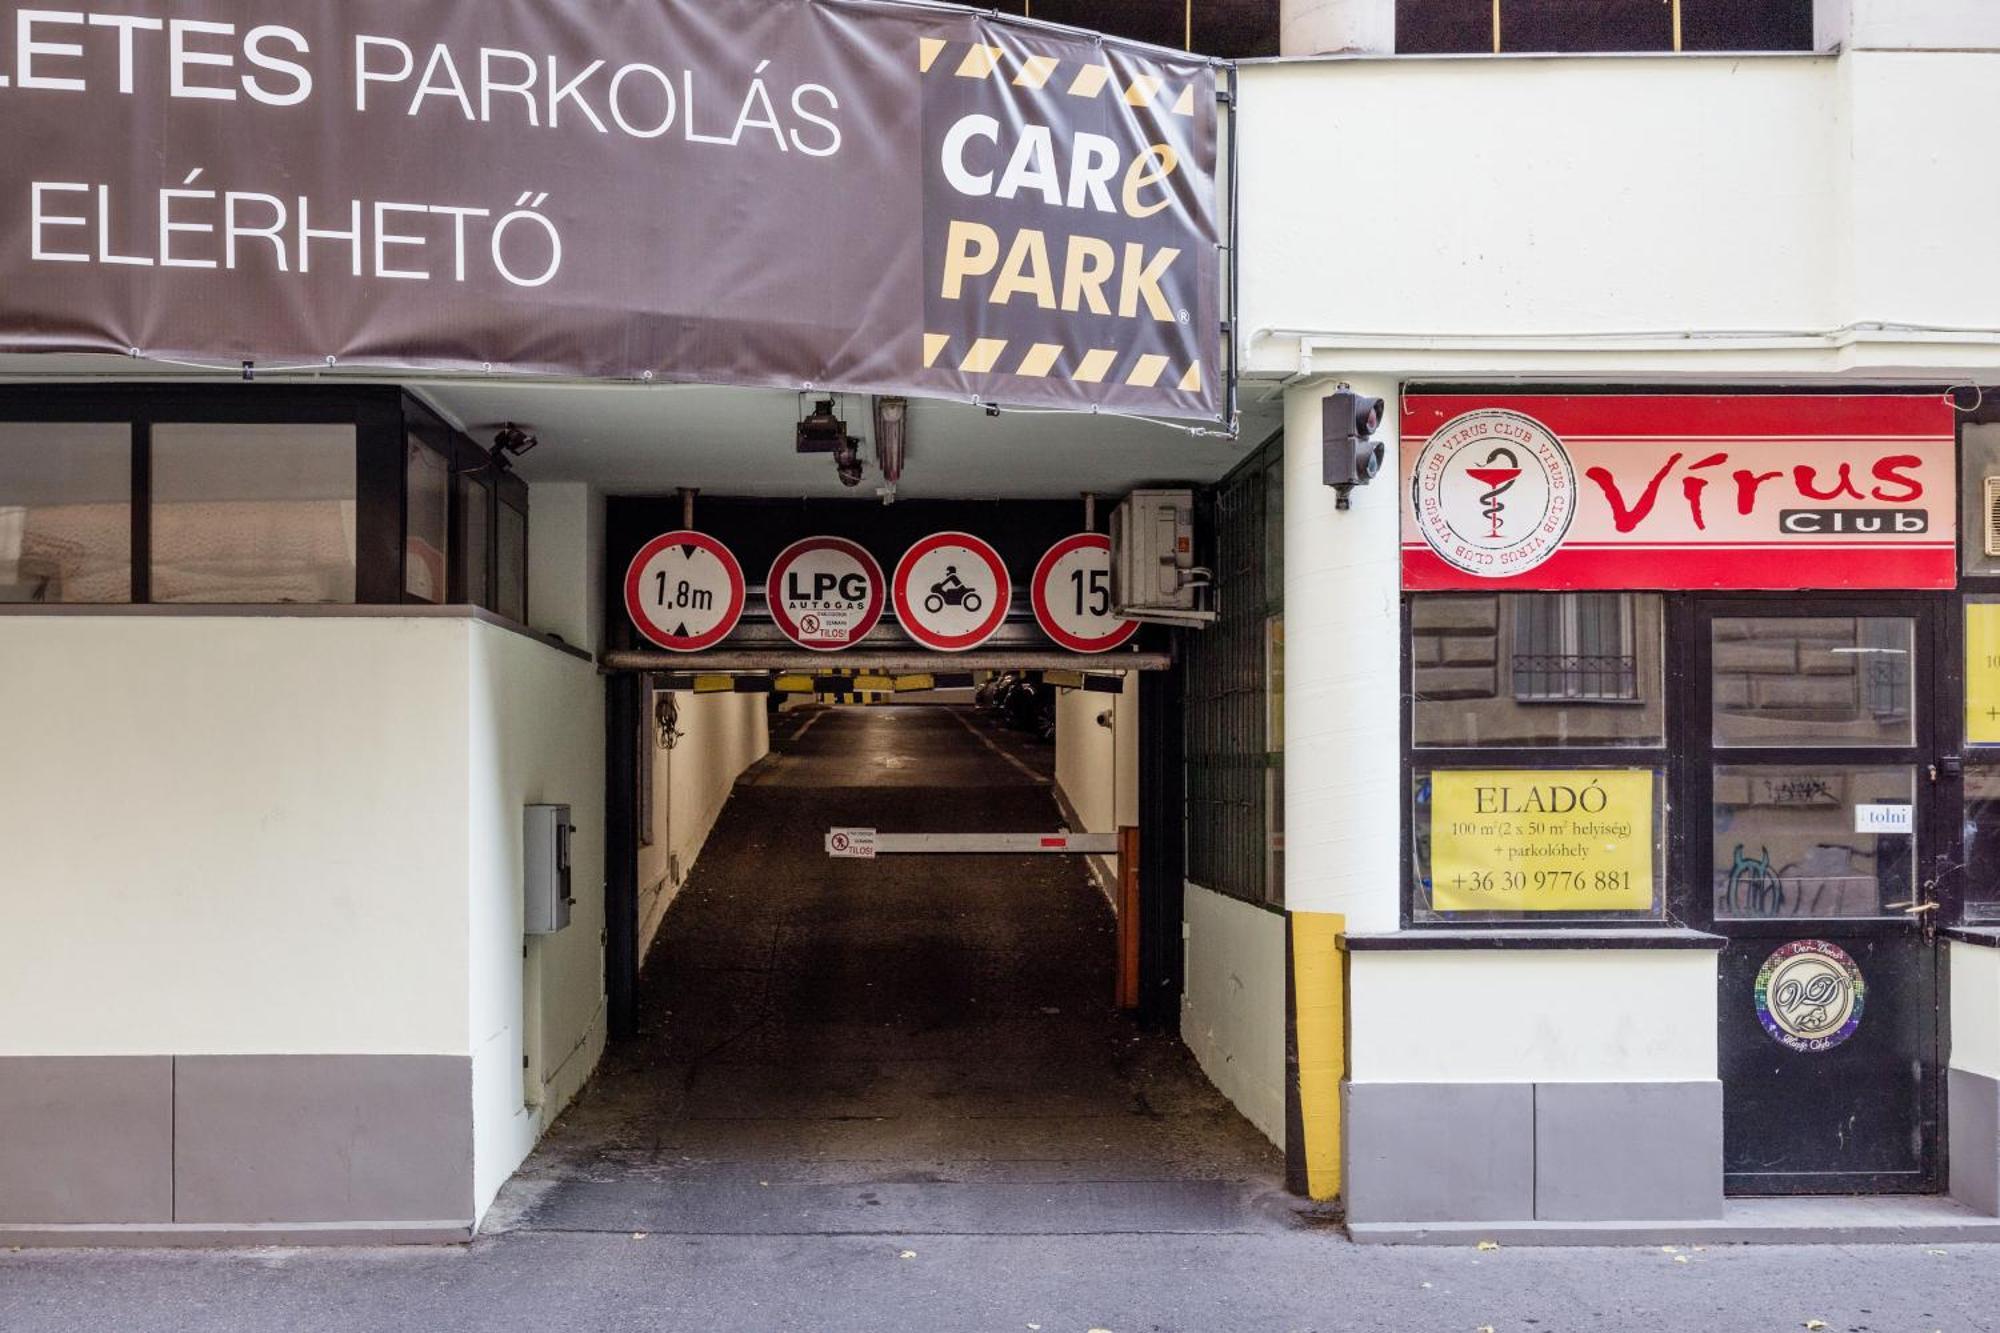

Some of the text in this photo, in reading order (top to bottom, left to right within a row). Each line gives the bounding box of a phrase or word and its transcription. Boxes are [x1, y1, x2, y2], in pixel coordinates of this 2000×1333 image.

[0, 8, 842, 157] ETES PARKOLÁS
[31, 167, 562, 287] ELÉRHETŐ
[1425, 423, 1565, 565] VIRUS CLUB VIRUS CLUB VIRUS CLUB VIRUS CLUB
[1585, 452, 1924, 533] Vírus
[1785, 512, 1925, 532] Club
[789, 572, 867, 601] LPG
[1071, 569, 1109, 617] 15
[789, 602, 865, 610] AUTOGAS
[1474, 778, 1608, 814] ELADÓ
[1452, 822, 1476, 836] 100
[1528, 822, 1545, 836] 50
[1573, 821, 1632, 839] helyiség)
[1870, 808, 1906, 823] tolni
[1508, 842, 1590, 861] parkolóhely
[1452, 870, 1631, 891] +36 30 9776 881
